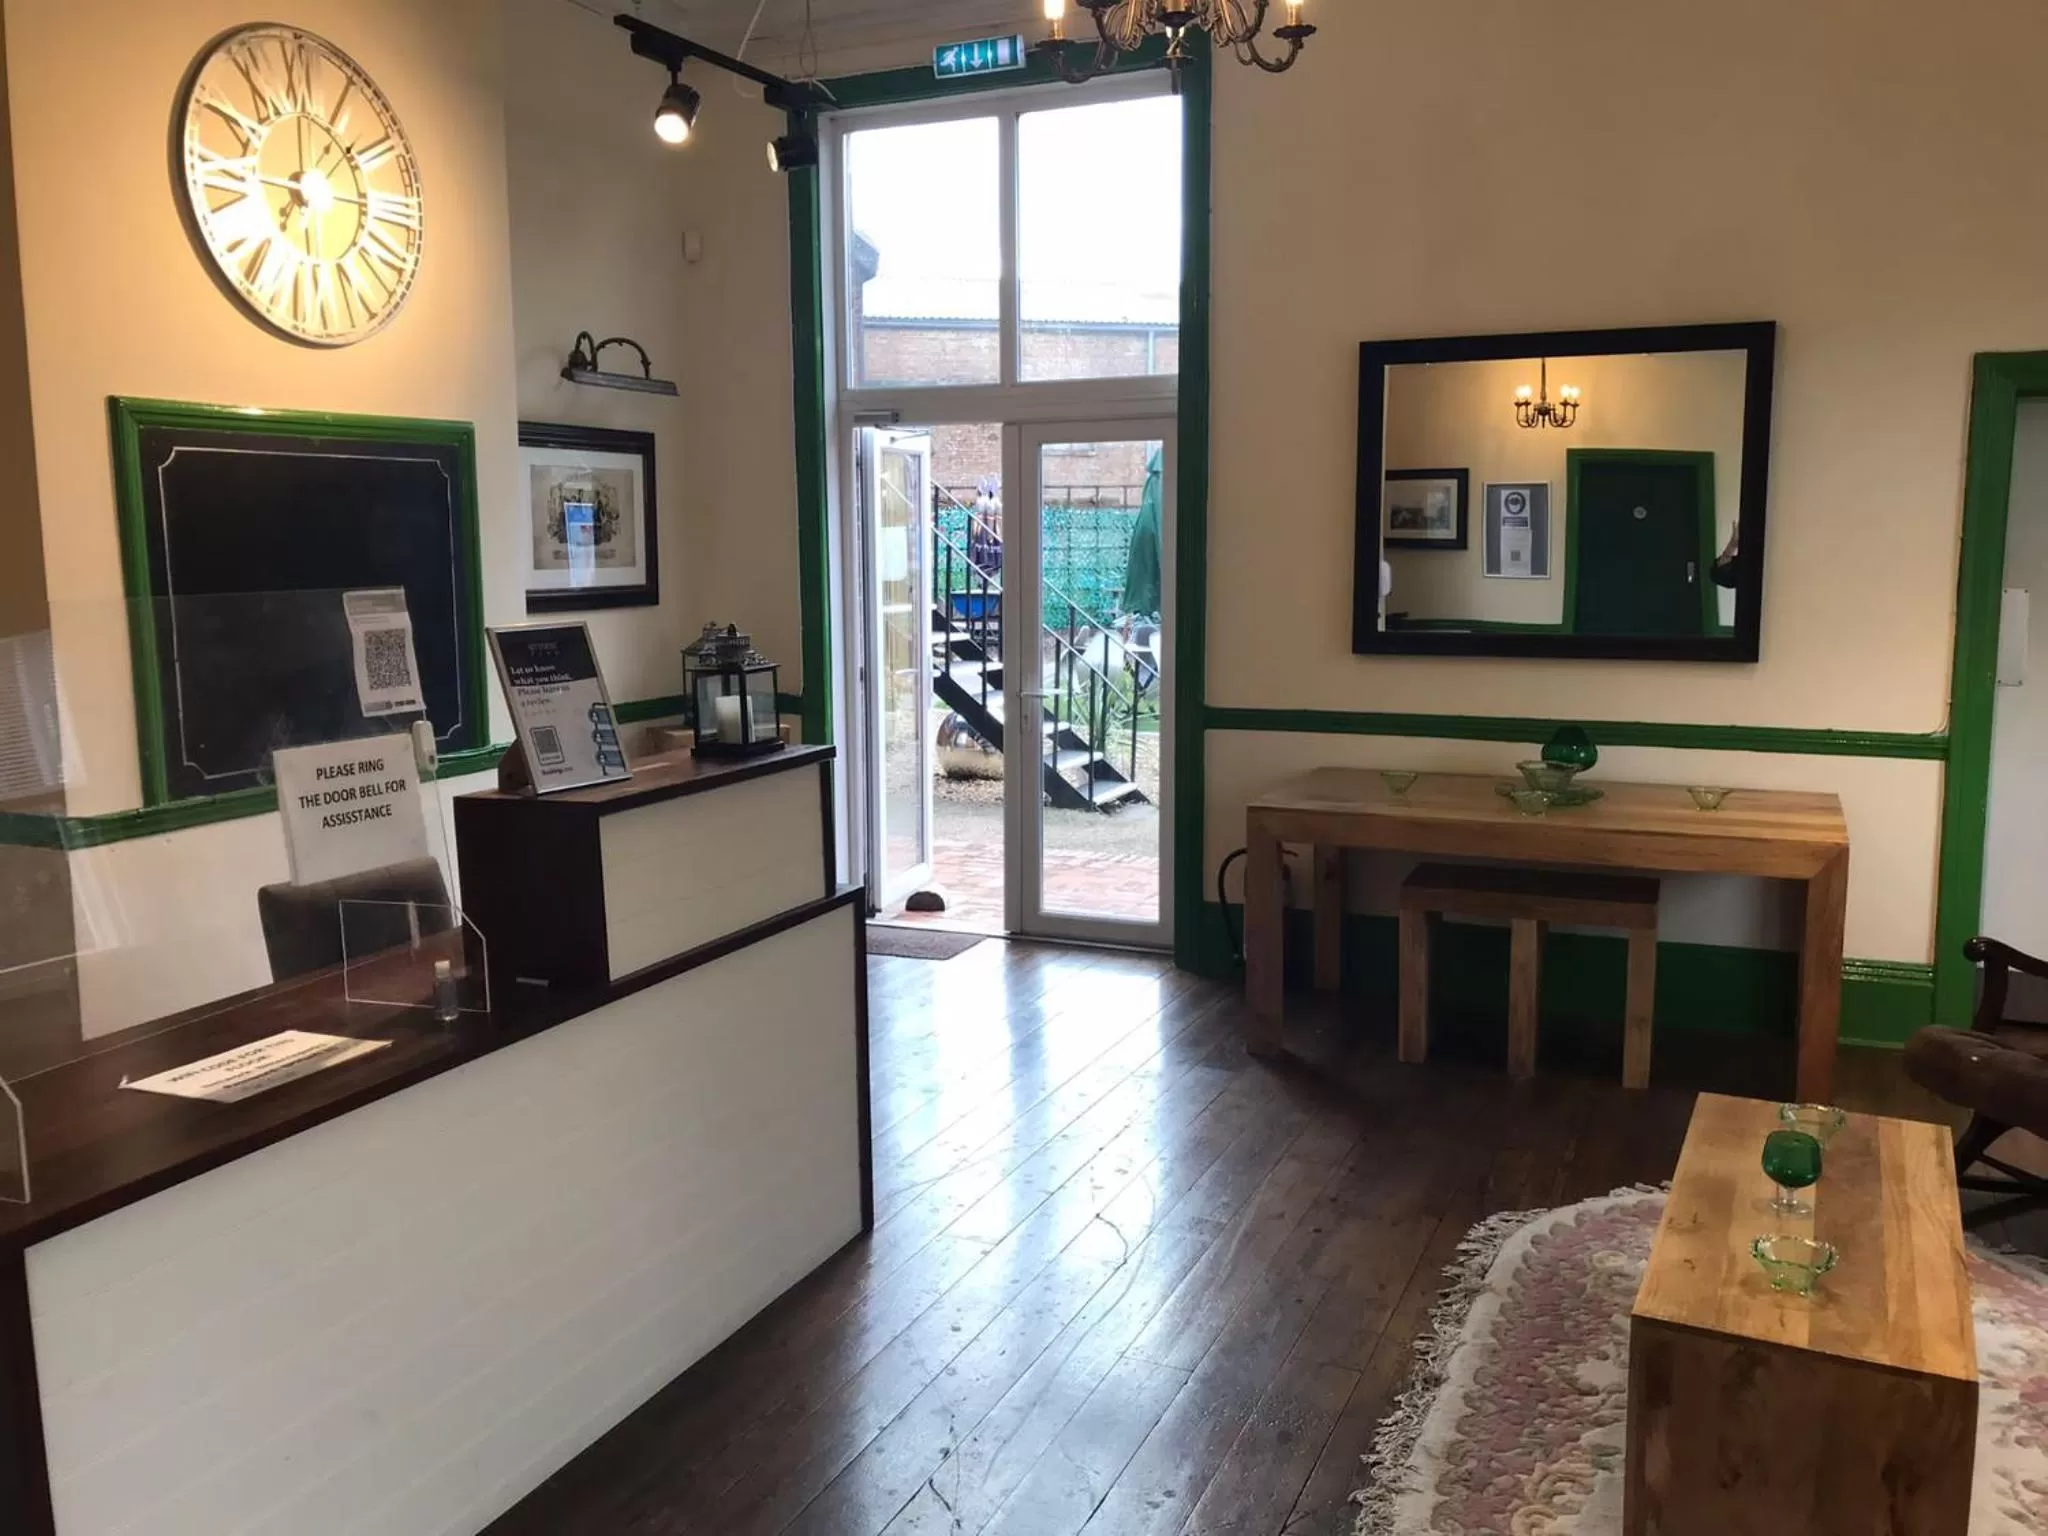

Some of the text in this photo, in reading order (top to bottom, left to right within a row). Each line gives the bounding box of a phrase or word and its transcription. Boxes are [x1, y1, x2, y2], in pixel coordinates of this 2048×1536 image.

[513, 676, 534, 686] what
[535, 676, 549, 686] you
[517, 687, 540, 697] Please
[316, 758, 385, 780] PLEASE RING
[298, 779, 406, 809] THE DOOR BELL FOR
[322, 804, 392, 829] ASSISSTANCE
